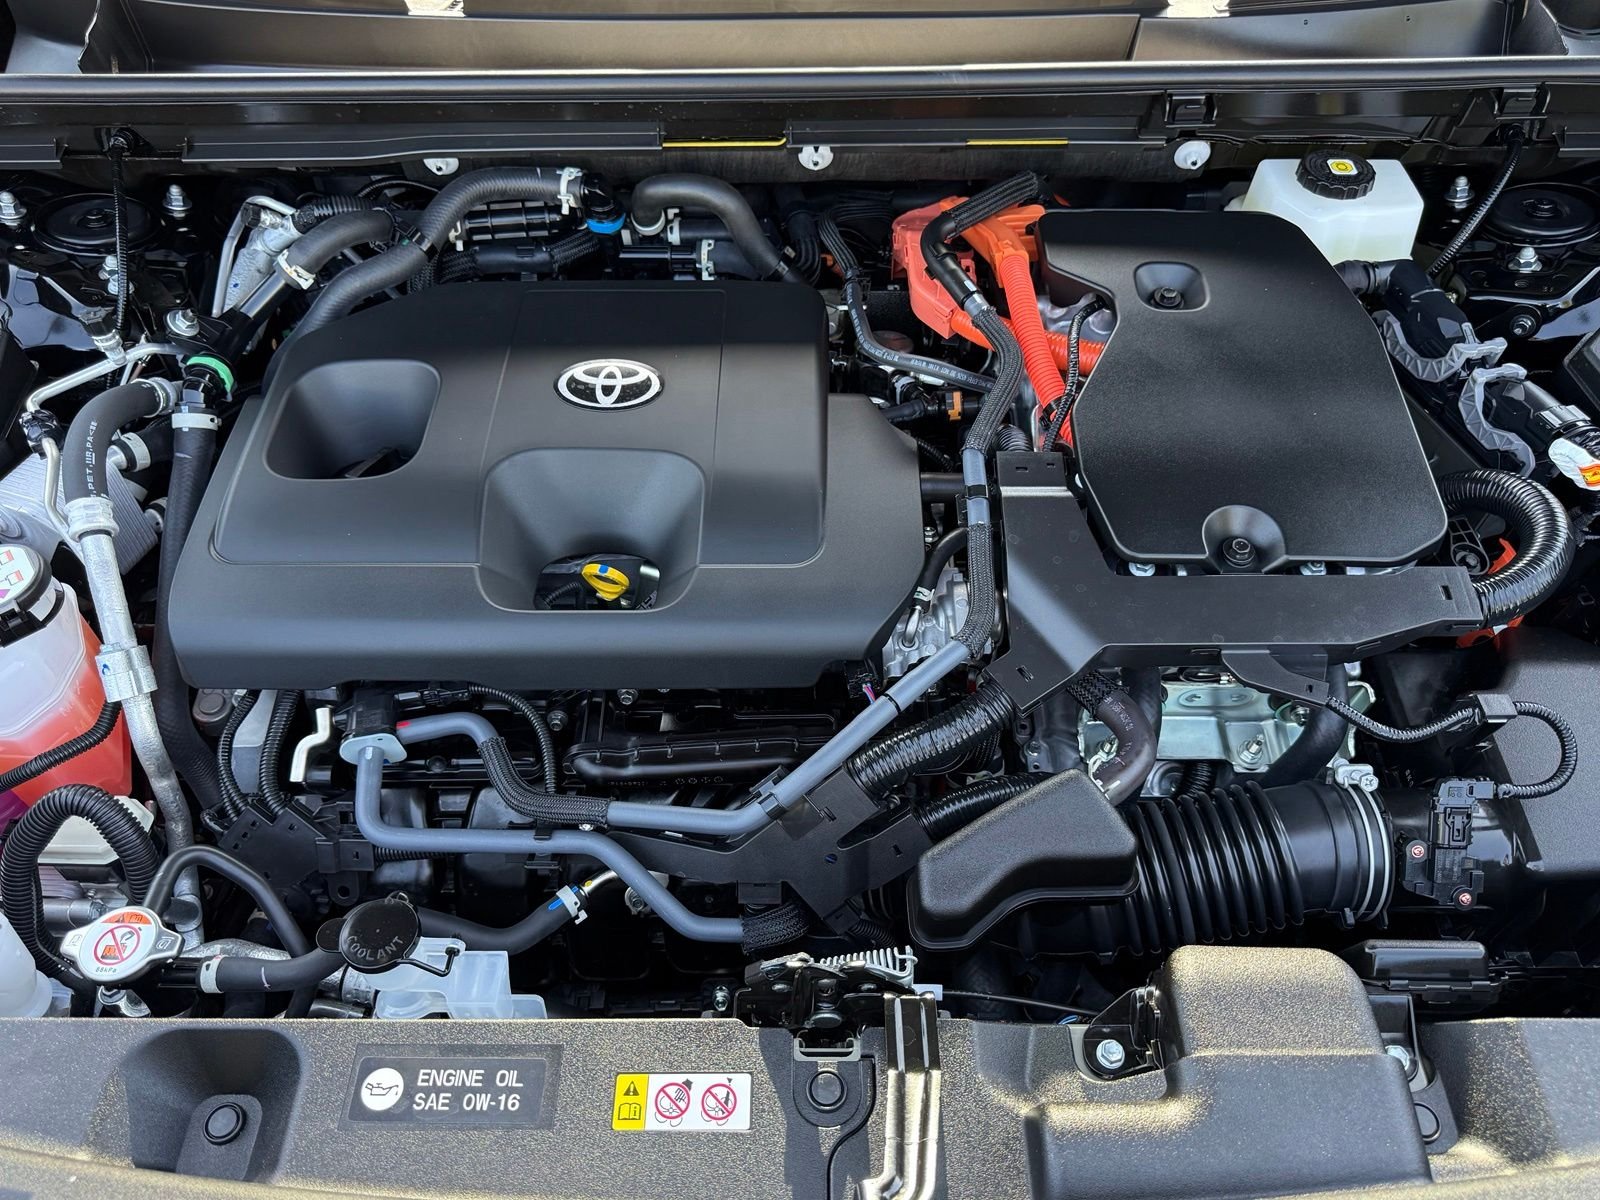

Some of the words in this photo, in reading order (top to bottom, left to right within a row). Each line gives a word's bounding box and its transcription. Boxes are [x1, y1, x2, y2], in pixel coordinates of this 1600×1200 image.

[346, 935, 404, 961] COOLANT
[417, 1069, 485, 1087] ENGINE
[496, 1069, 524, 1088] OIL
[413, 1093, 451, 1111] SAE
[462, 1093, 521, 1111] 0W-16
